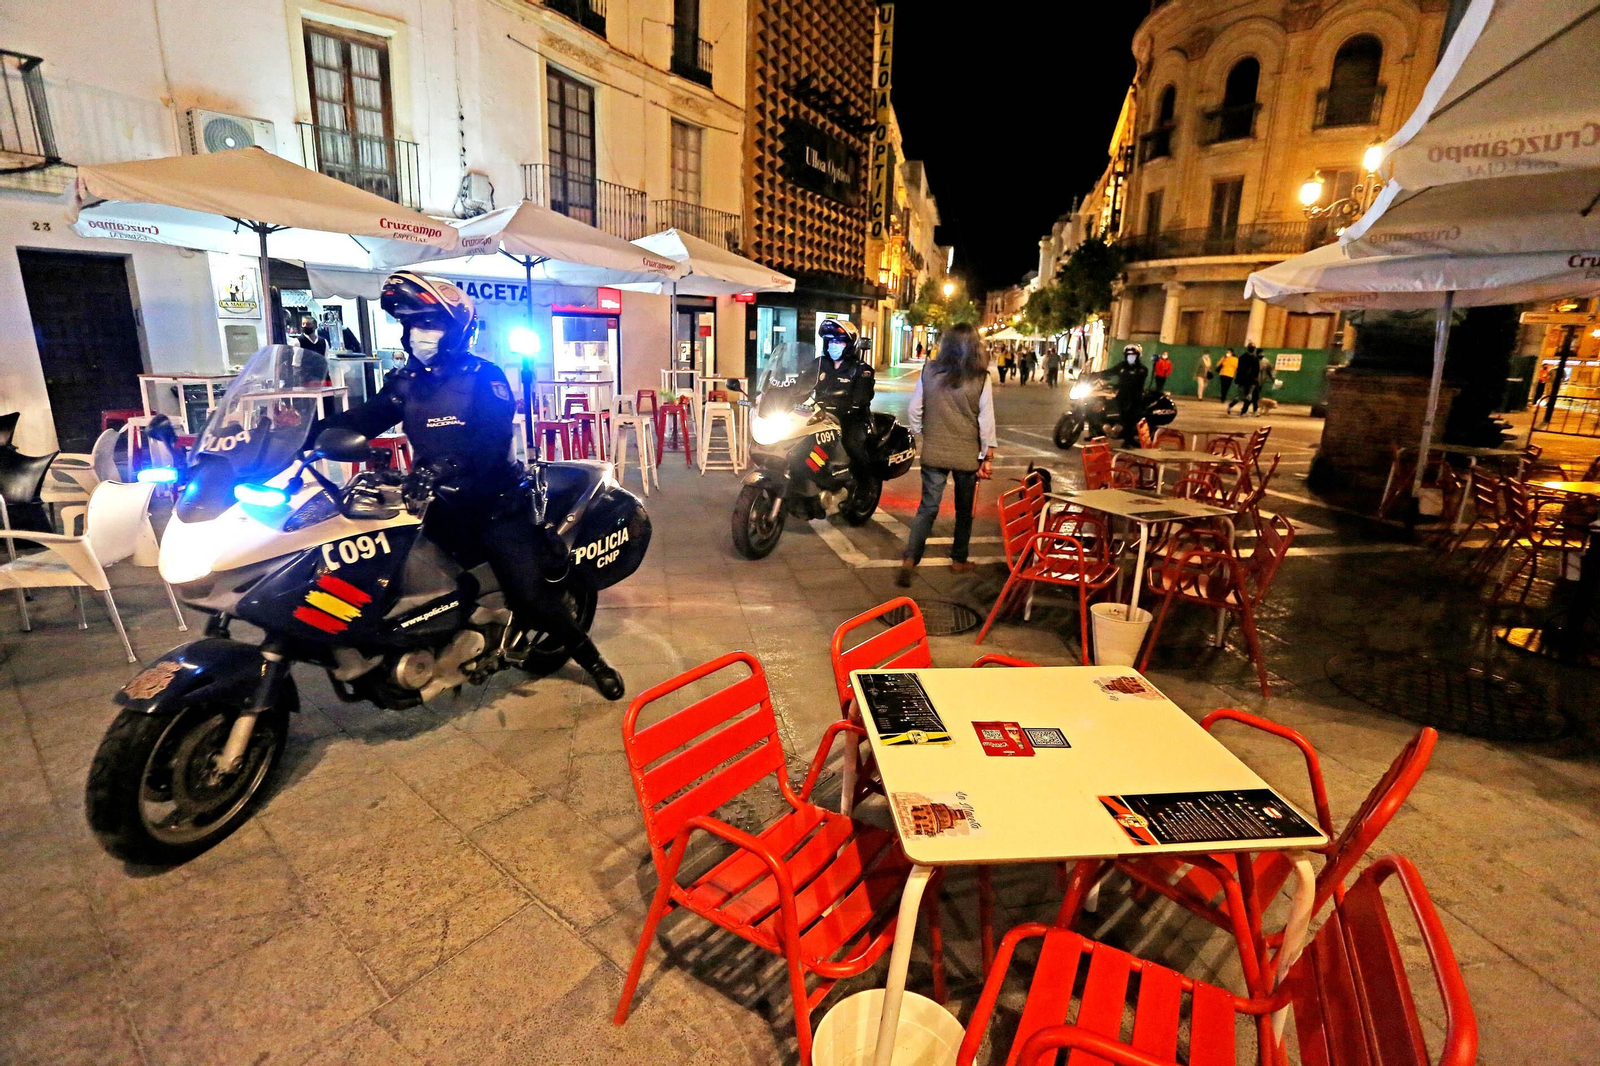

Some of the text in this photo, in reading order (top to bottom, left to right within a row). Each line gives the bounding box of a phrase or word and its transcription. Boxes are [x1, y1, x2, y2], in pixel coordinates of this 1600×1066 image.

[871, 7, 893, 237] ULLOA OPTICO
[805, 146, 826, 173] Ulloa
[32, 221, 51, 232] 23
[379, 217, 442, 238] Cruzcampo
[392, 232, 428, 244] ESPECIAL
[338, 531, 391, 564] 091
[575, 527, 629, 565] POLICIA
[597, 549, 620, 569] CNP
[401, 600, 460, 629] www.policia.es
